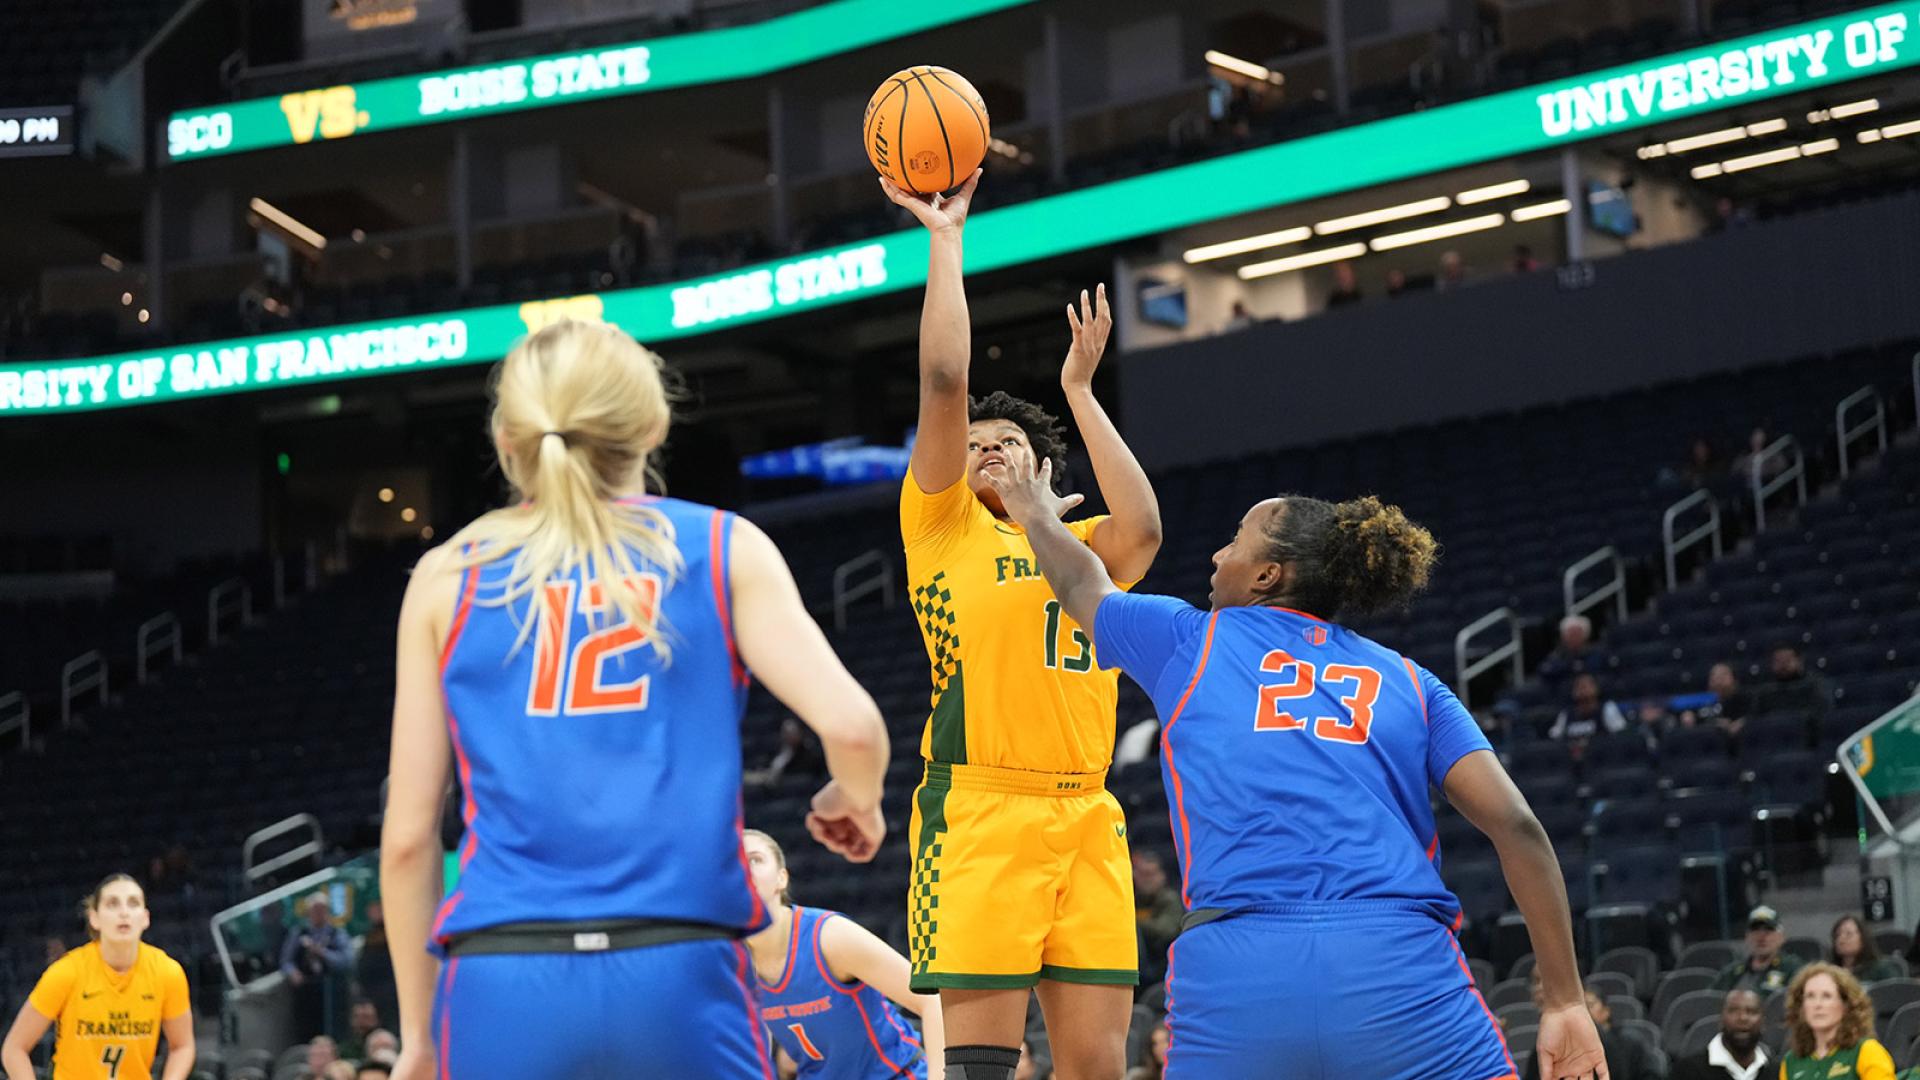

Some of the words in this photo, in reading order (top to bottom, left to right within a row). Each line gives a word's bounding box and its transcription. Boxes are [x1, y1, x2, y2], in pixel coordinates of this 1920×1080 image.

[168, 112, 233, 156] SCO
[280, 86, 370, 144] VS.
[418, 65, 528, 115] BOISE
[531, 46, 651, 98] STATE
[1536, 29, 1833, 136] UNIVERSITY
[1844, 12, 1907, 68] OF
[23, 117, 59, 143] PM
[671, 270, 774, 328] BOISE
[775, 243, 888, 305] STATE
[118, 357, 165, 400] OF
[170, 346, 249, 392] SAN
[254, 320, 468, 383] FRANCISCO
[526, 572, 662, 717] 12
[1044, 600, 1092, 674] 13
[1254, 649, 1382, 745] 23
[102, 1044, 124, 1080] 4
[787, 1023, 825, 1061] 1
